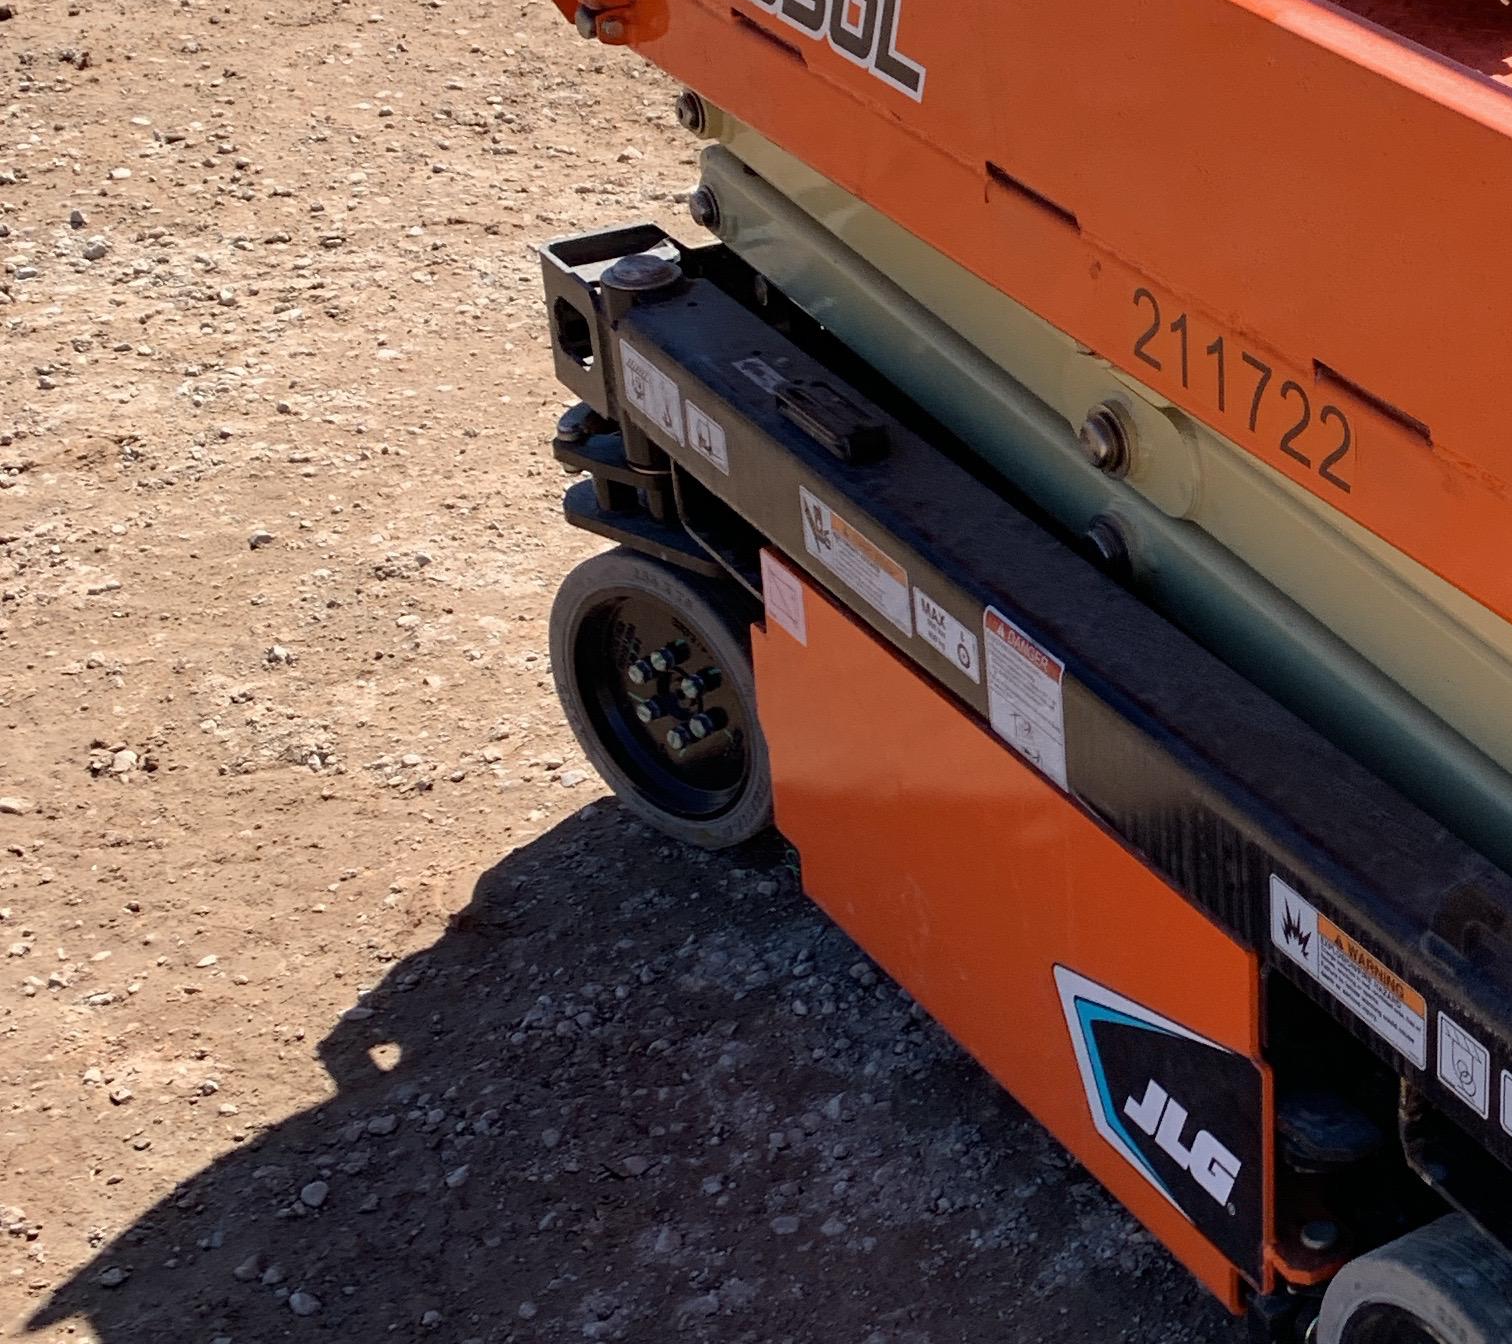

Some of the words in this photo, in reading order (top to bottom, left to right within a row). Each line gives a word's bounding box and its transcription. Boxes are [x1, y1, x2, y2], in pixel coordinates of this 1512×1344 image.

[1133, 287, 1352, 494] 211722
[1007, 631, 1050, 672] DANGER
[1347, 941, 1405, 998] WARNING
[1123, 1078, 1242, 1208] JLG
